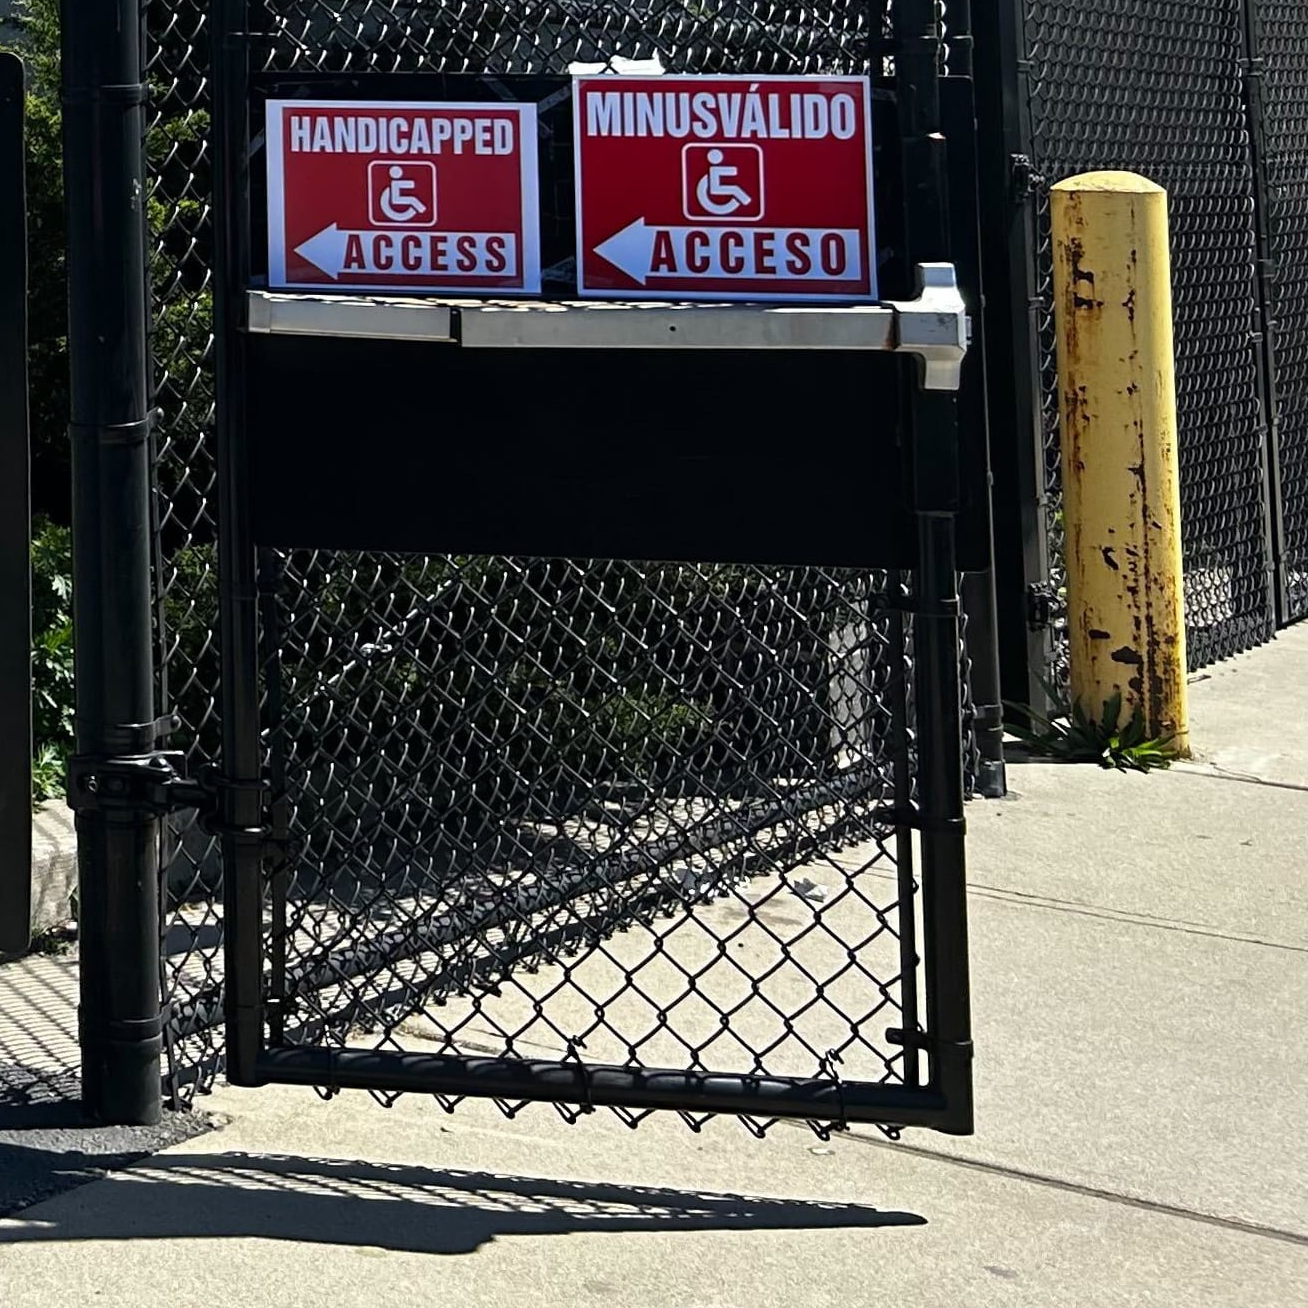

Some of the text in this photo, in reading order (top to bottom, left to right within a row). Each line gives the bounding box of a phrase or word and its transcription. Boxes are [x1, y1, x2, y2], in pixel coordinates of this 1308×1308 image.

[586, 83, 857, 140] MINUSVÁLIDO
[290, 115, 514, 156] HANDICAPPED
[342, 233, 507, 274] ACCESS
[649, 230, 848, 277] ACCESO
